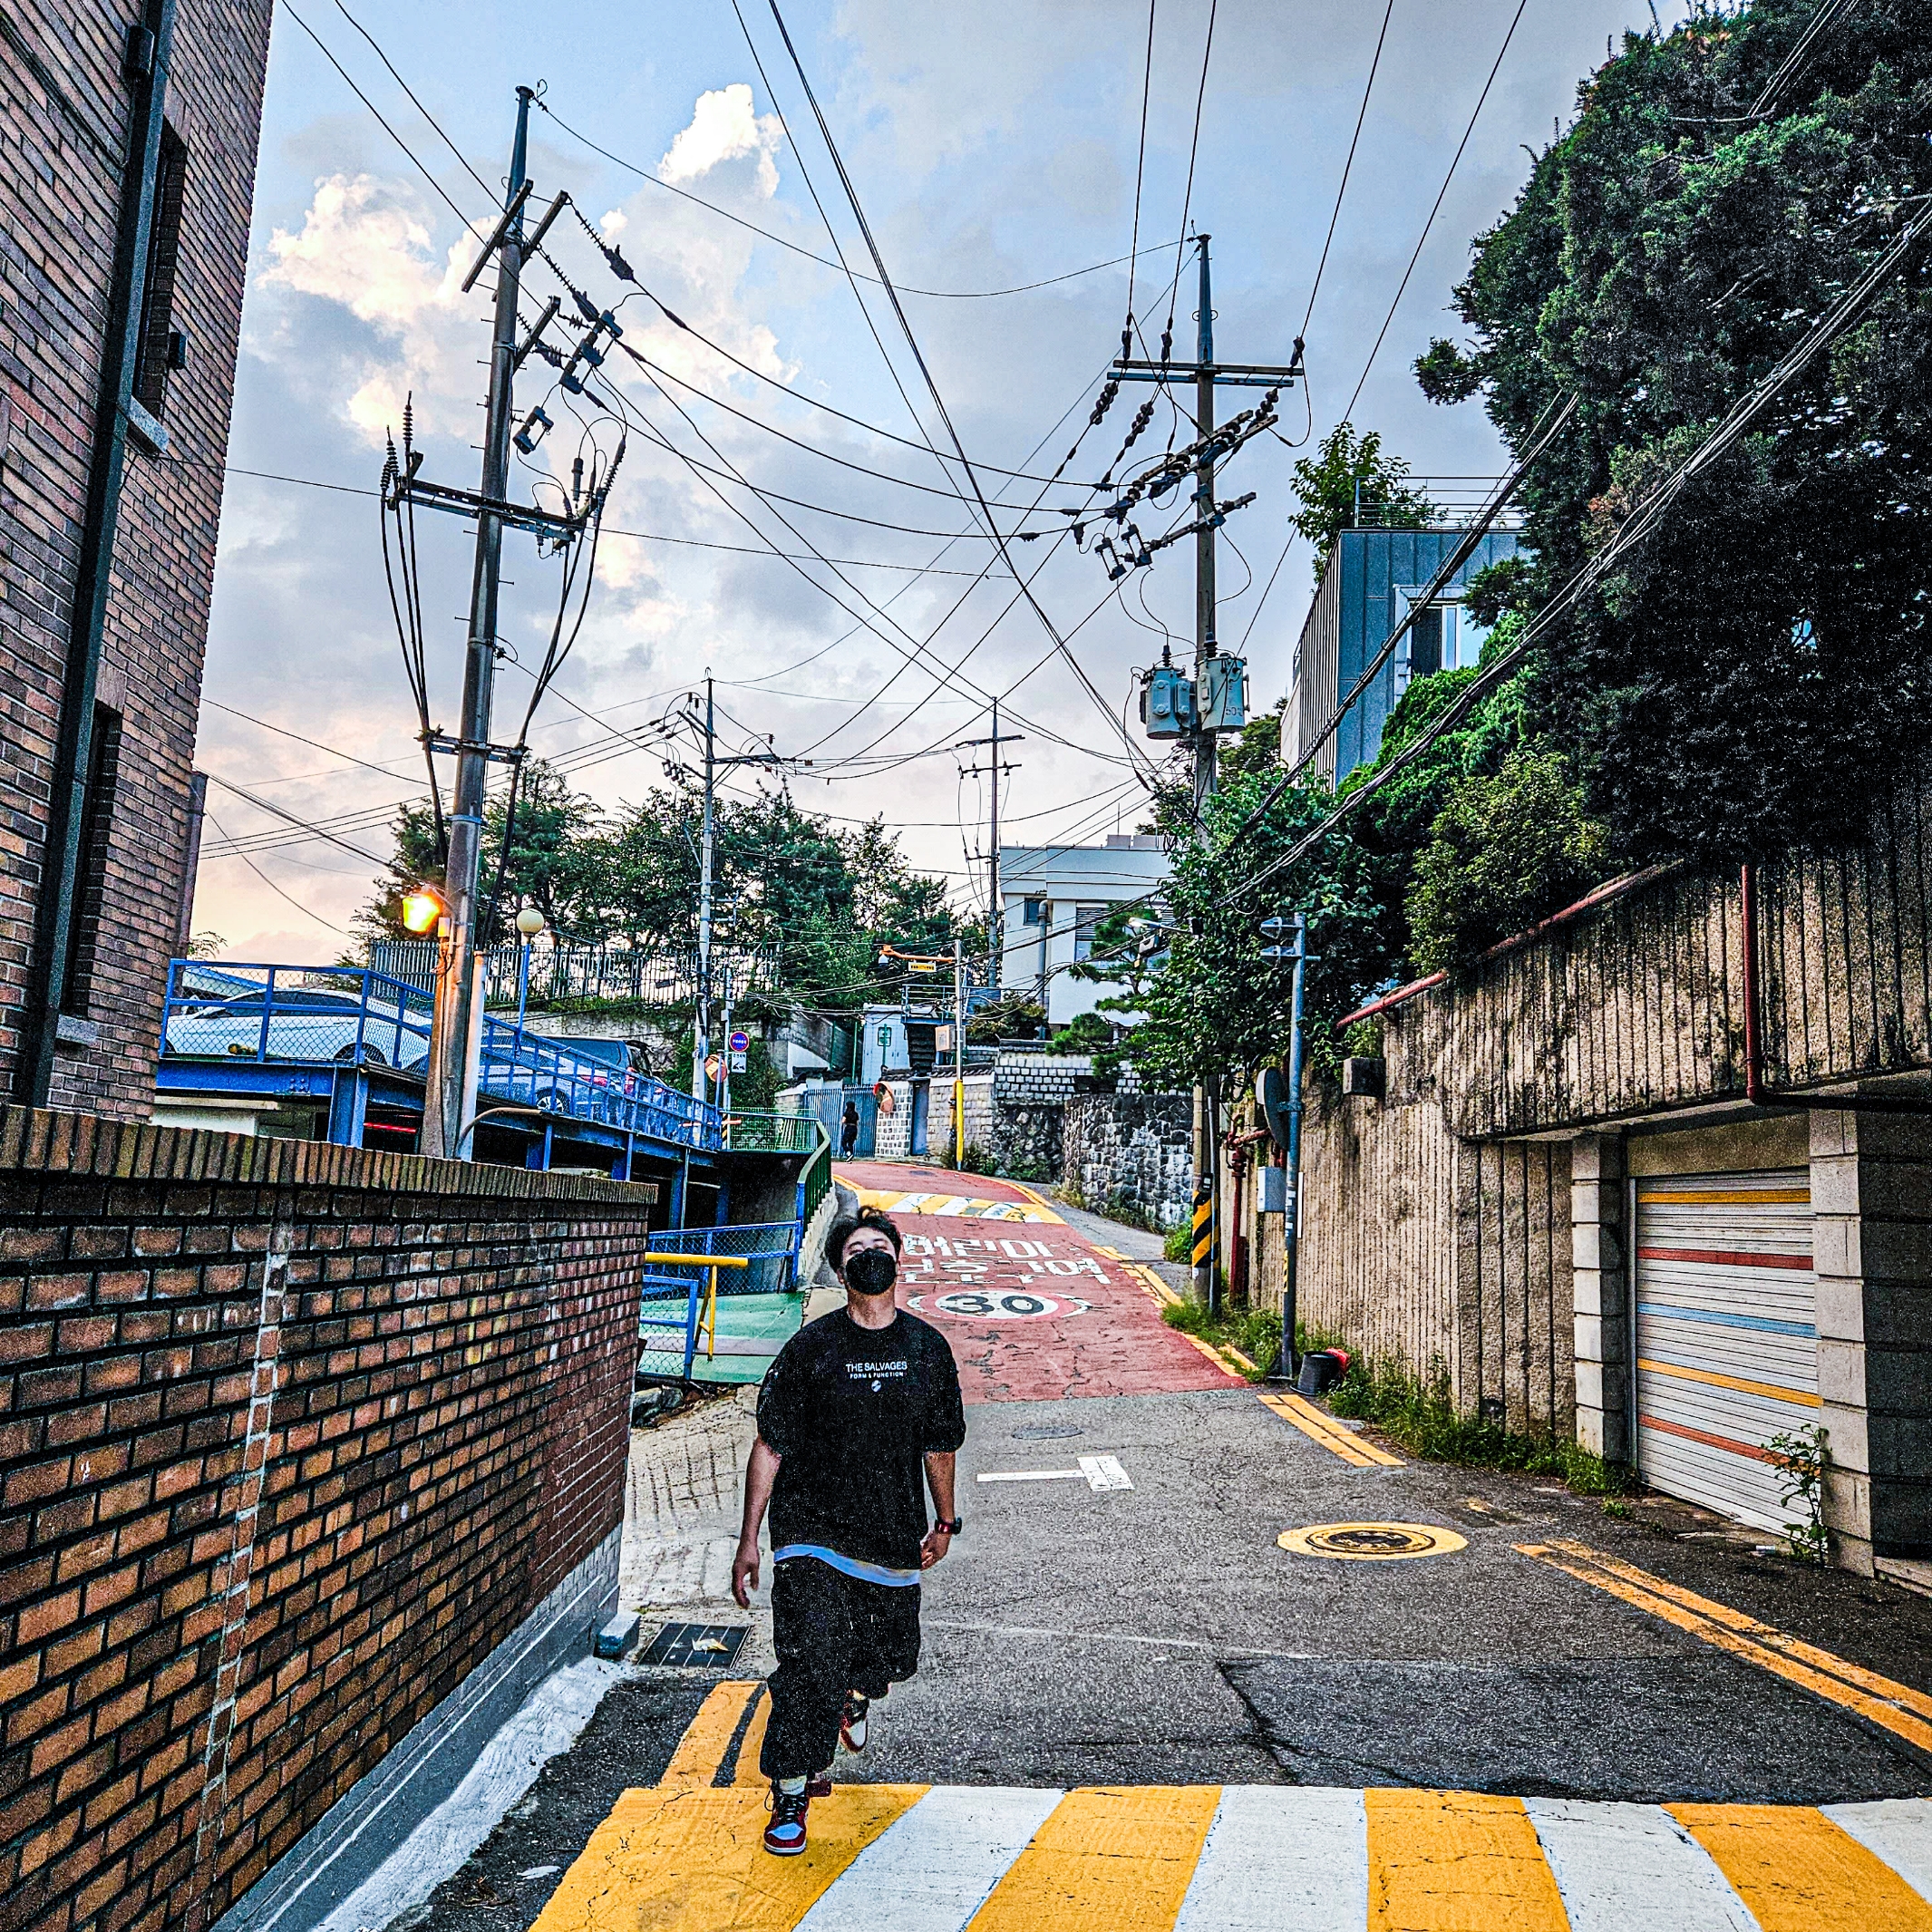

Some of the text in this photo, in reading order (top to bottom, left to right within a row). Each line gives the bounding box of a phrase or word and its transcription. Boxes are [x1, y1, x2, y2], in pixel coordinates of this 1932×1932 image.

[945, 1295, 1044, 1315] 30
[846, 1361, 908, 1372] THE SALVAGES
